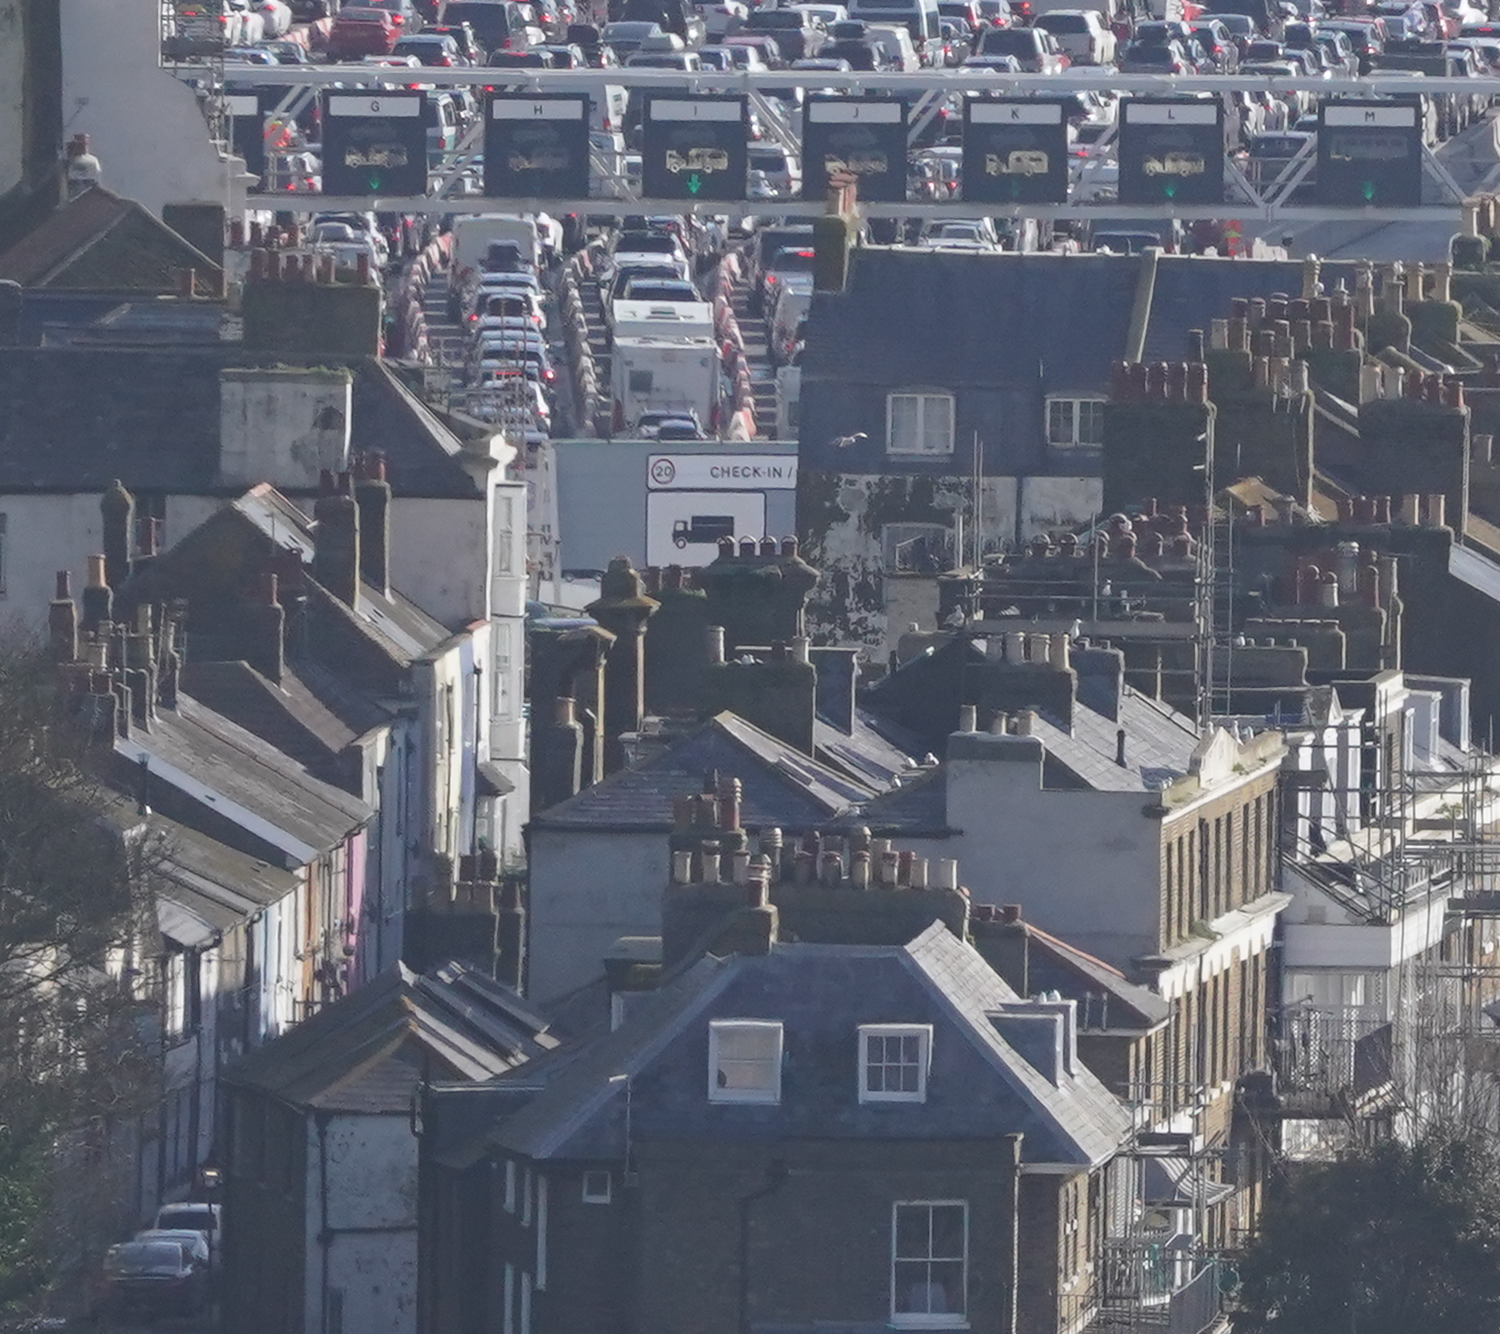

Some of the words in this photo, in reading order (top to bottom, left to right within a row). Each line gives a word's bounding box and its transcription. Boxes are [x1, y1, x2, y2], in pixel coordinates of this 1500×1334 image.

[371, 101, 380, 112] G
[534, 105, 543, 114] H
[1365, 111, 1376, 122] M
[656, 466, 672, 477] 20
[710, 466, 783, 478] CHECK-IN
